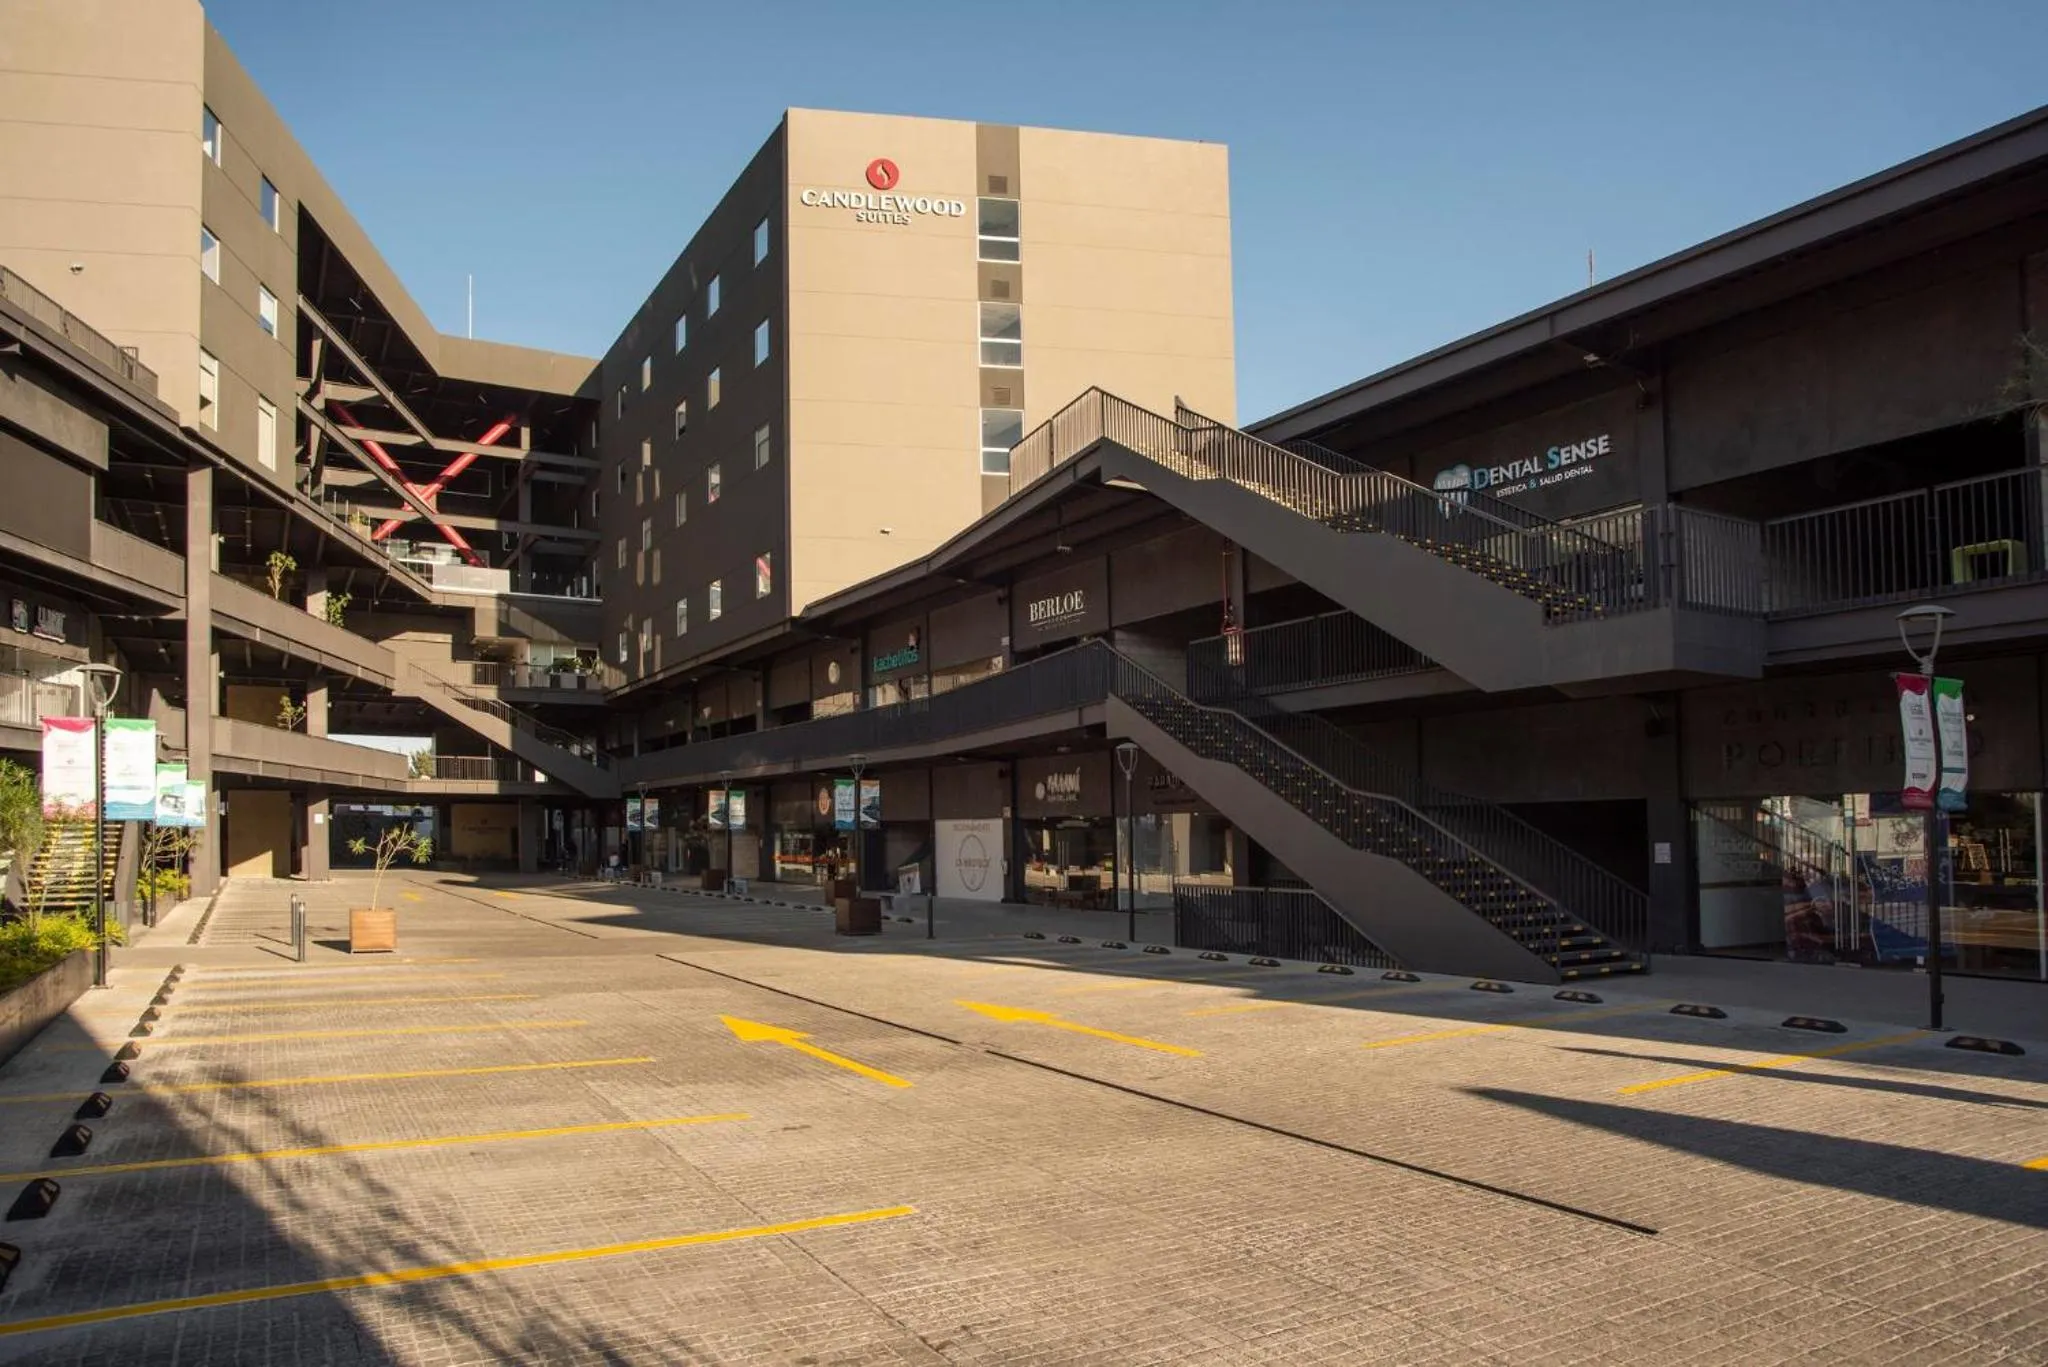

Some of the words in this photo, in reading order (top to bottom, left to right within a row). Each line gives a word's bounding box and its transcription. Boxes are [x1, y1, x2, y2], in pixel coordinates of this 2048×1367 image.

[801, 188, 967, 218] CANDLEWOOD
[856, 210, 913, 225] SUITES
[1473, 455, 1543, 490] DENTAL
[1547, 434, 1612, 470] SENSE
[1529, 478, 1537, 489] &
[1539, 473, 1564, 486] SALUD
[1564, 465, 1594, 480] DENTAL
[1029, 589, 1085, 622] BERLOE
